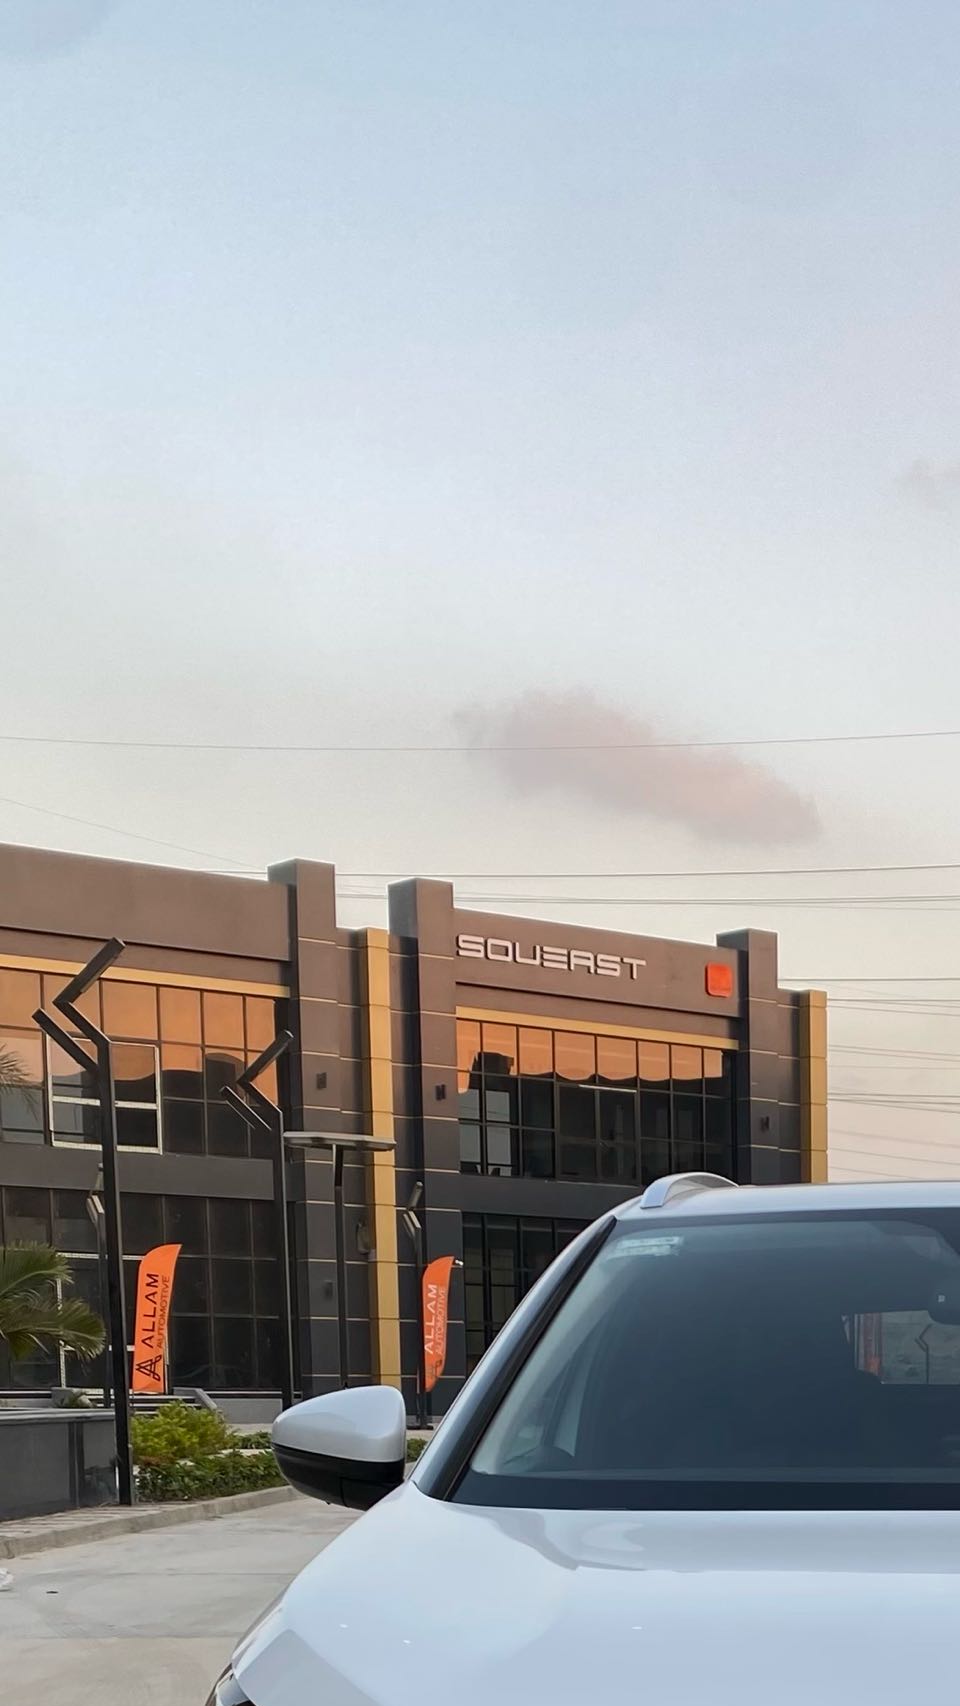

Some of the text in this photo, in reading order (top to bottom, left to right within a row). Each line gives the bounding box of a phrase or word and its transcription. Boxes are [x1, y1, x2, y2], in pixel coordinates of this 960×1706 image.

[141, 1273, 159, 1349] ALLAM
[156, 1275, 170, 1349] AUTOMOTIVE
[424, 1284, 438, 1355] ALLAM
